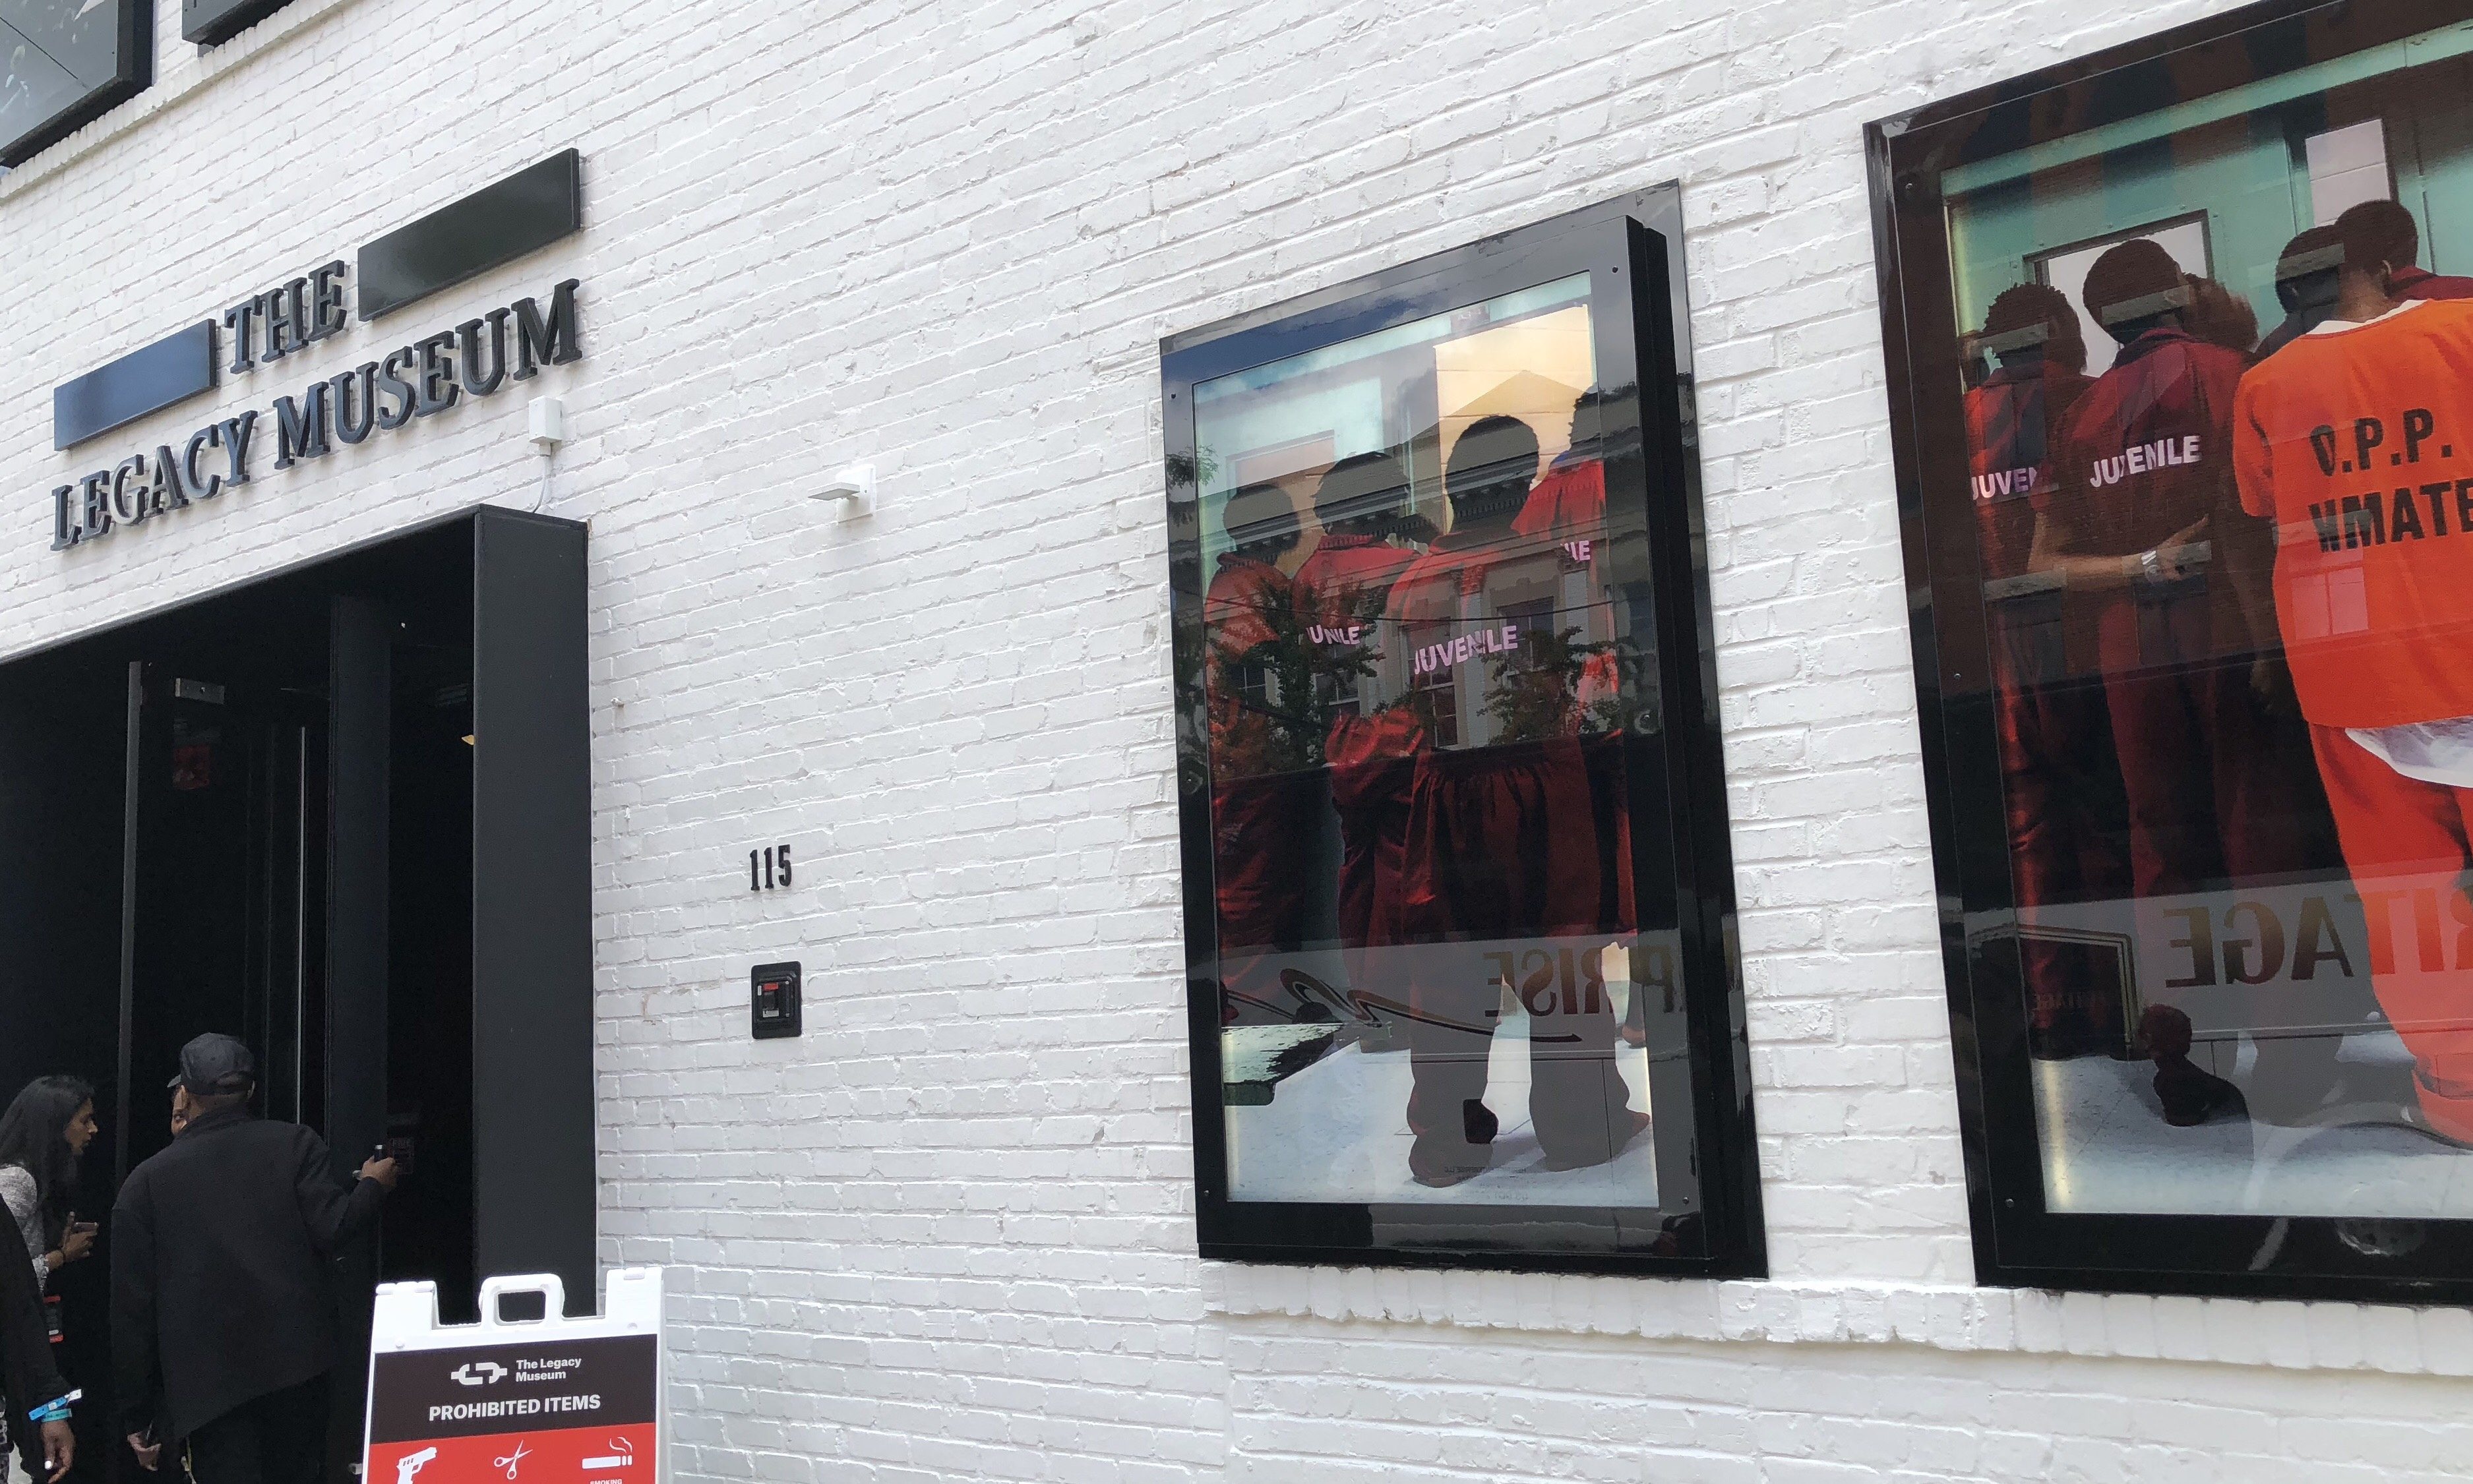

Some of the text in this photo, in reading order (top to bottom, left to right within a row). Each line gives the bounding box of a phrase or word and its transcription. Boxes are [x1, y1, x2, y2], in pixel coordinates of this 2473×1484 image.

[224, 260, 347, 374] THE
[51, 278, 582, 551] LEGACY MUSEUM
[749, 844, 792, 891] 115
[516, 1358, 582, 1370] The Legacy
[516, 1371, 566, 1382] Museum
[429, 1394, 601, 1421] PROHIBITED ITEMS
